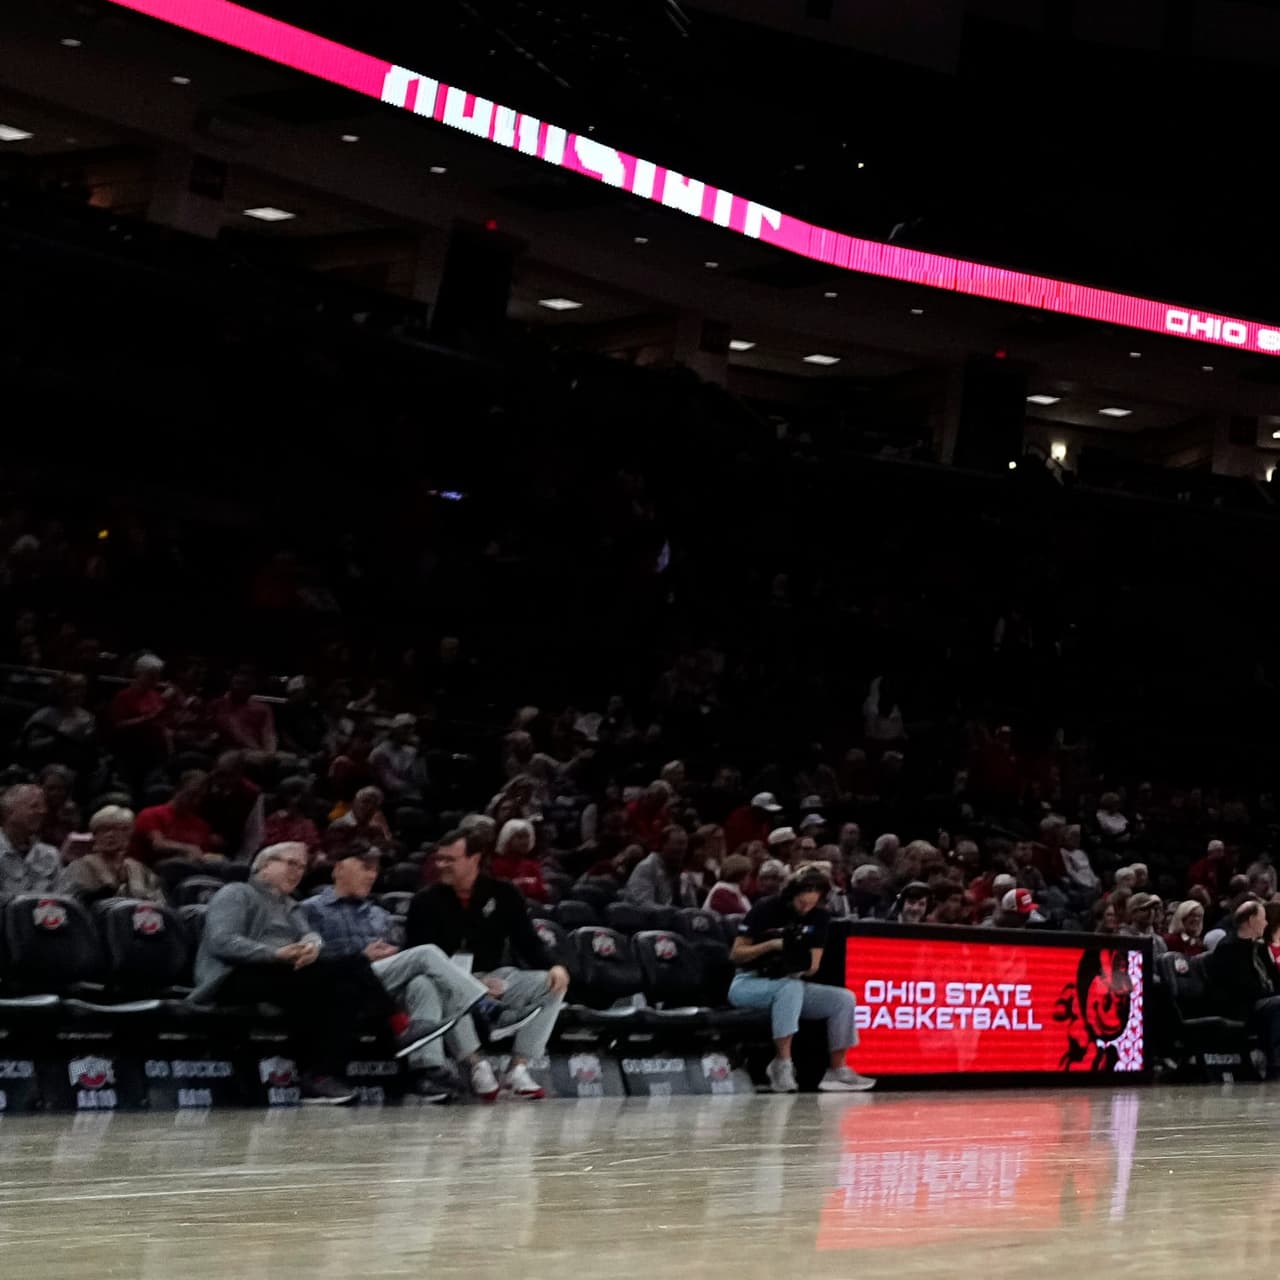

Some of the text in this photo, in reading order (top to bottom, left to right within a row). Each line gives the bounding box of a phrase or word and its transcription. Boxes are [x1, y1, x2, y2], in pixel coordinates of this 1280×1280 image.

[1165, 308, 1247, 345] OHIO
[864, 979, 1032, 1007] OHIO STATE
[853, 1005, 1043, 1031] BASKETBALL
